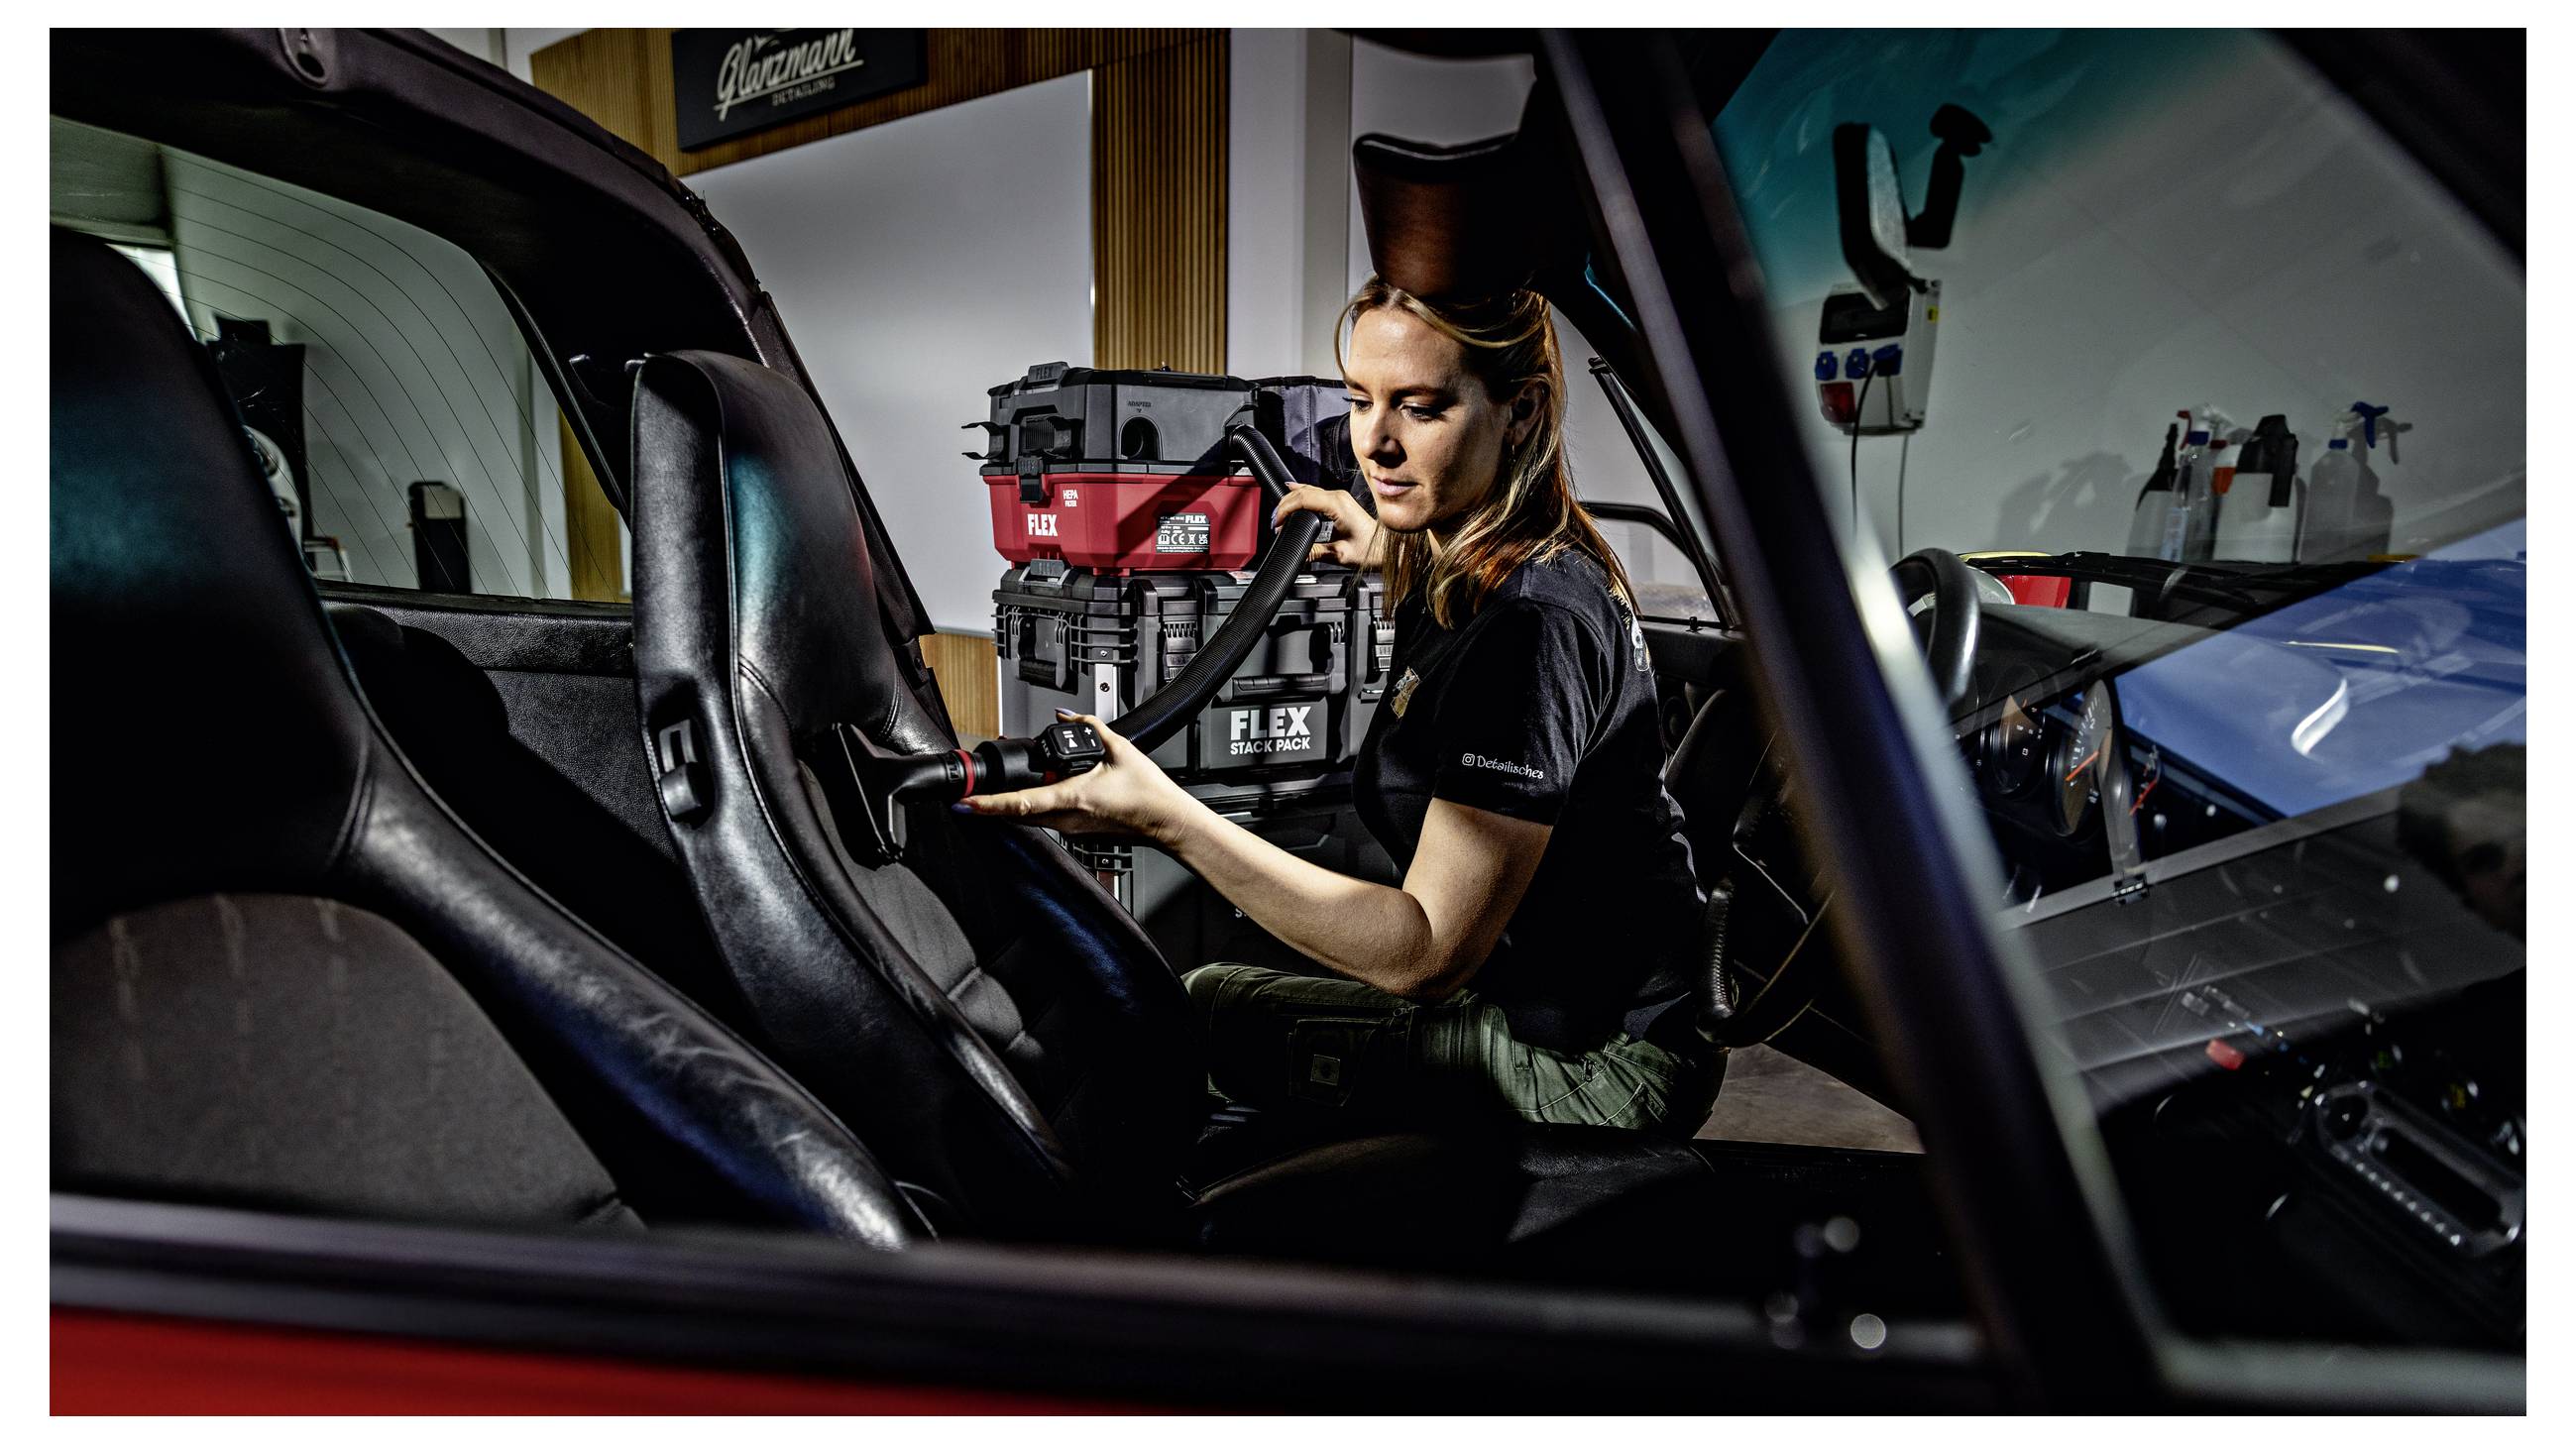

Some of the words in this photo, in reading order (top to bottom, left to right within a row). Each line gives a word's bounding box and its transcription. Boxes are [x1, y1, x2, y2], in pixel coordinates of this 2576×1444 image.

[717, 29, 856, 122] Glanzmann
[772, 76, 836, 106] DETAILING
[1063, 490, 1078, 500] HEPA
[1027, 513, 1059, 536] FLEX
[1185, 514, 1206, 523] FLEX
[1230, 706, 1311, 740] FLEX
[1230, 739, 1273, 755] STACK
[1276, 736, 1311, 752] PACK
[1477, 755, 1543, 778] Detailisches
